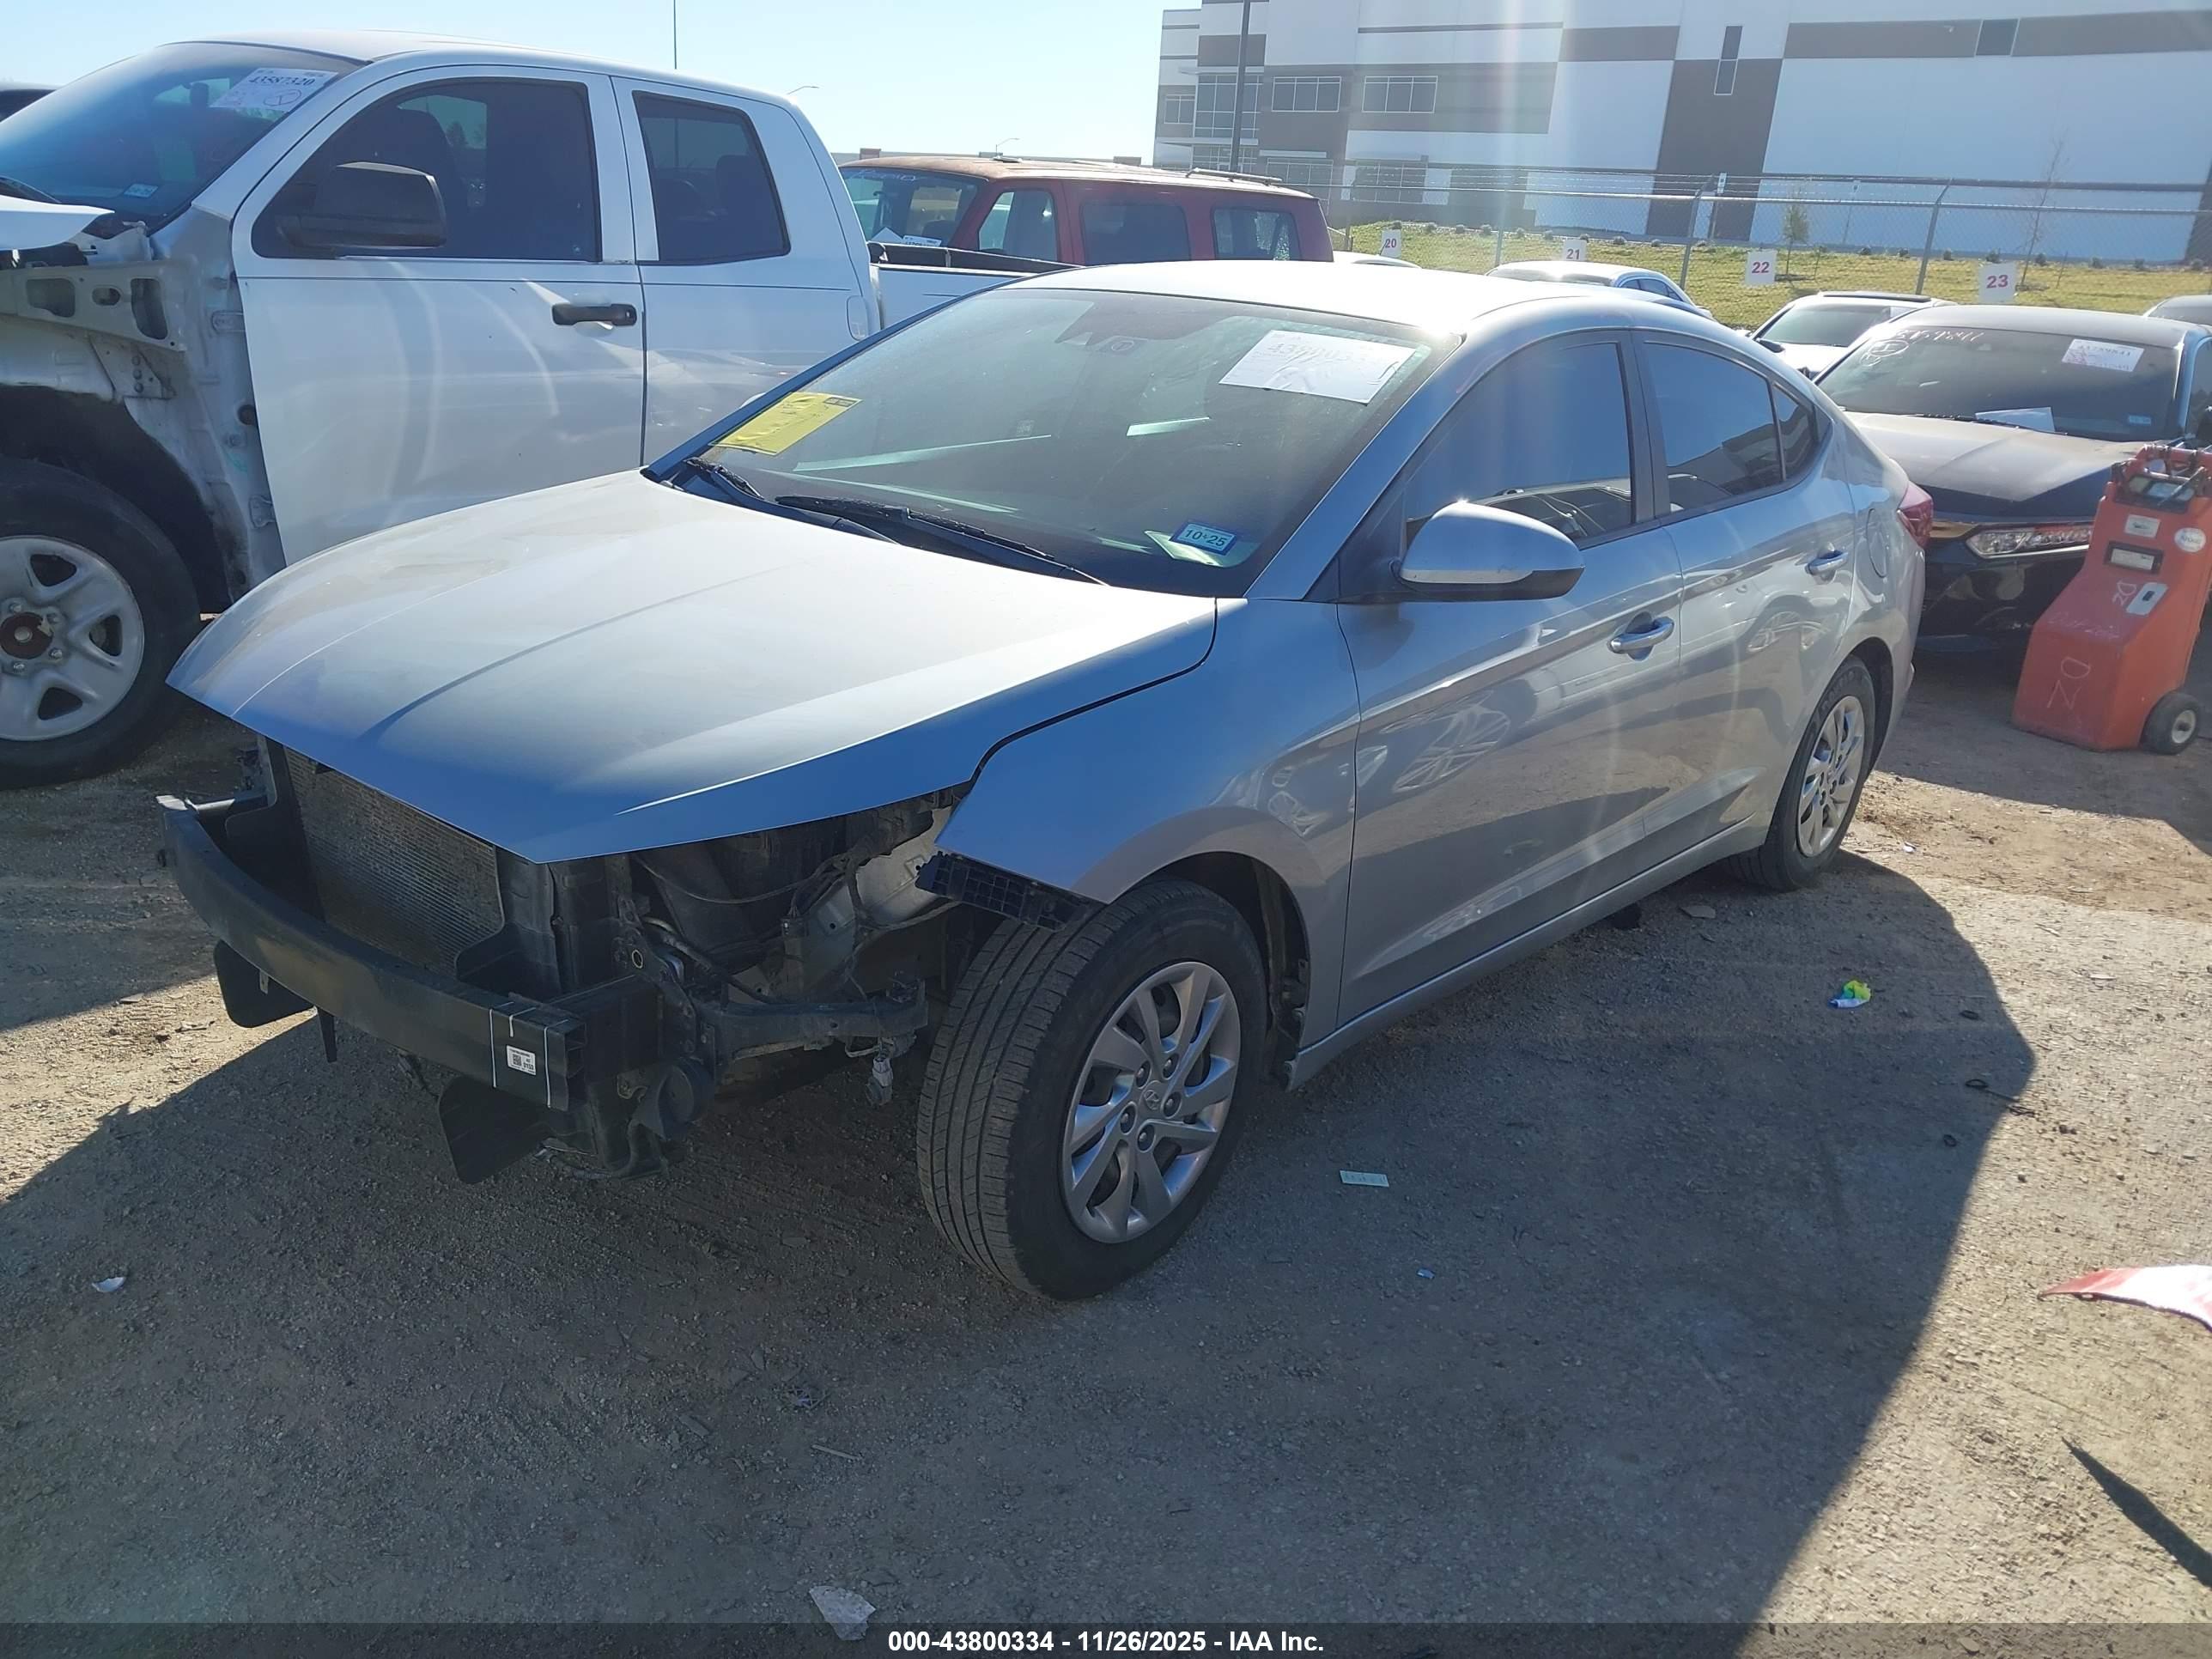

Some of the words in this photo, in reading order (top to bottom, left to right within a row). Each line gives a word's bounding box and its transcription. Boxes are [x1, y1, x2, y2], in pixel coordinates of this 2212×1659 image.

[1384, 238, 1397, 248] 20
[1565, 248, 1580, 260] 21
[1751, 261, 1770, 274] 22
[1986, 274, 2008, 289] 23
